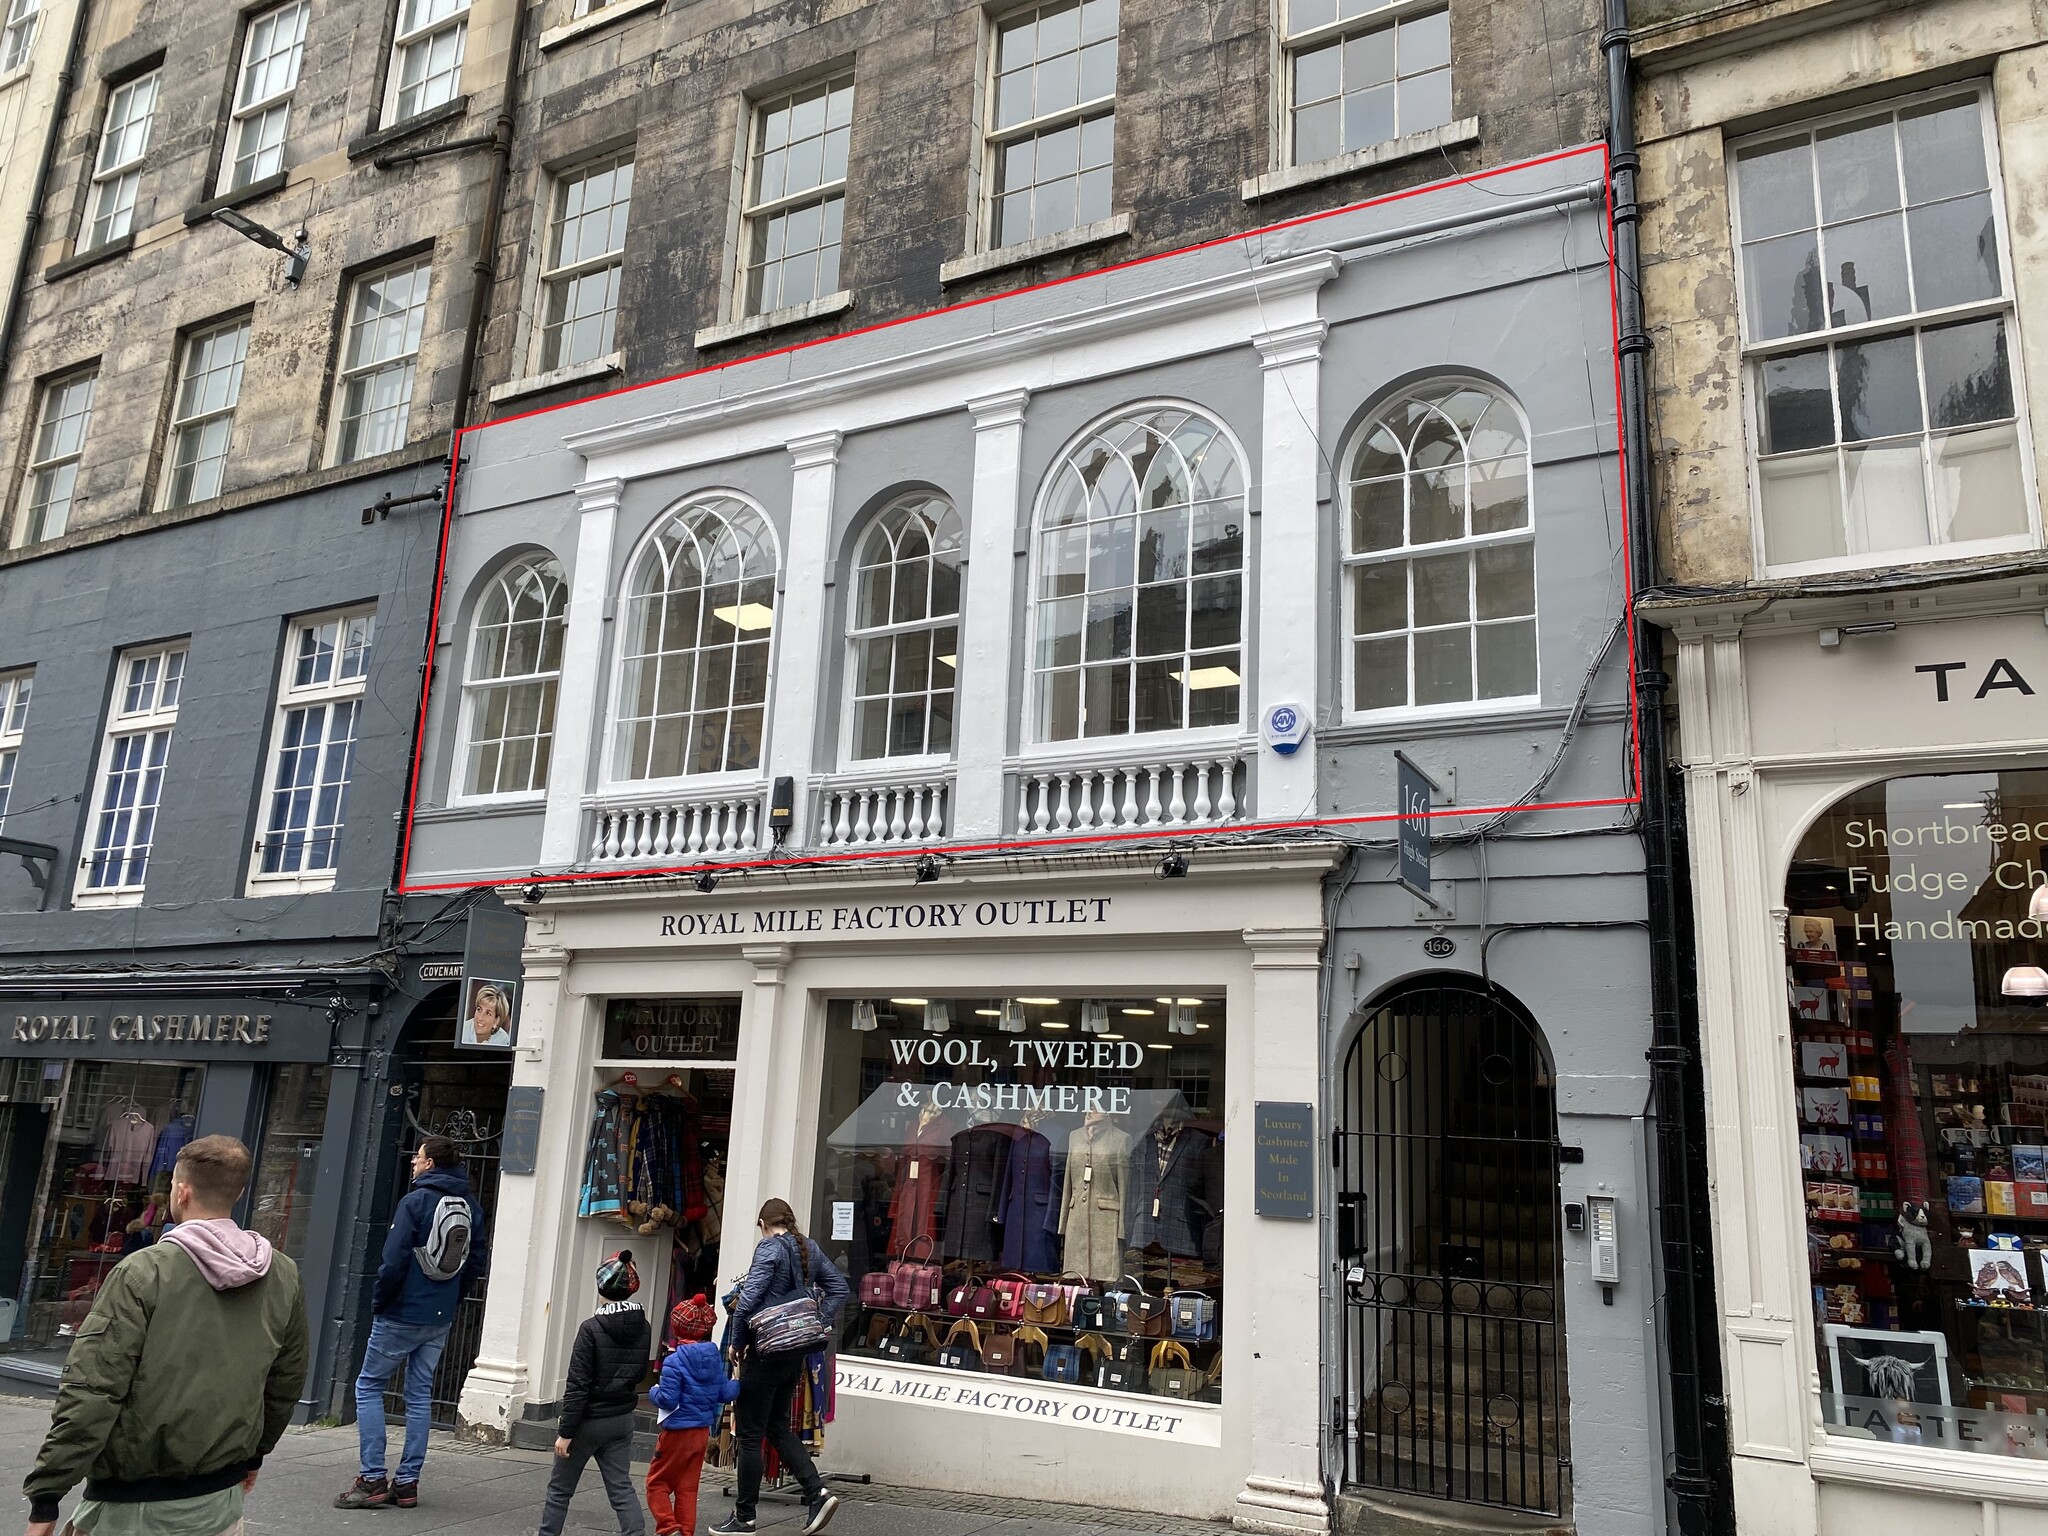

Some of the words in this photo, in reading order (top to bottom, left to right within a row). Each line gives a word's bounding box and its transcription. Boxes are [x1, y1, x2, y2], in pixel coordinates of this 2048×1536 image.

[1404, 784, 1427, 837] 166
[1403, 838, 1415, 862] High
[1415, 847, 1428, 869] Street
[1848, 863, 1981, 900] Fudge,
[660, 912, 745, 936] ROYAL
[752, 909, 823, 933] MILE
[831, 903, 967, 931] FACTORY
[975, 897, 1112, 926] OUTLET
[1854, 910, 2048, 941] Handmad
[1427, 940, 1450, 952] 166
[423, 966, 464, 977] COVENANT
[634, 1007, 726, 1026] FACTORY
[11, 1015, 97, 1042] ROYAL
[108, 1015, 272, 1044] CASHMERE
[635, 1035, 718, 1053] OUTLET
[890, 1039, 998, 1073] WOOL,
[1009, 1040, 1144, 1069] TWEED
[896, 1082, 920, 1107] &
[931, 1082, 1132, 1114] CASHMERE
[1264, 1118, 1303, 1131] Luxury
[1257, 1135, 1310, 1148] Cashmere
[1269, 1154, 1298, 1165] Made
[1278, 1171, 1289, 1182] In
[1260, 1189, 1307, 1201] Scotland
[835, 1372, 884, 1393] OYAL
[889, 1380, 951, 1402] MILE
[954, 1388, 1068, 1418] FACTORY
[1072, 1404, 1183, 1434] OUTLET
